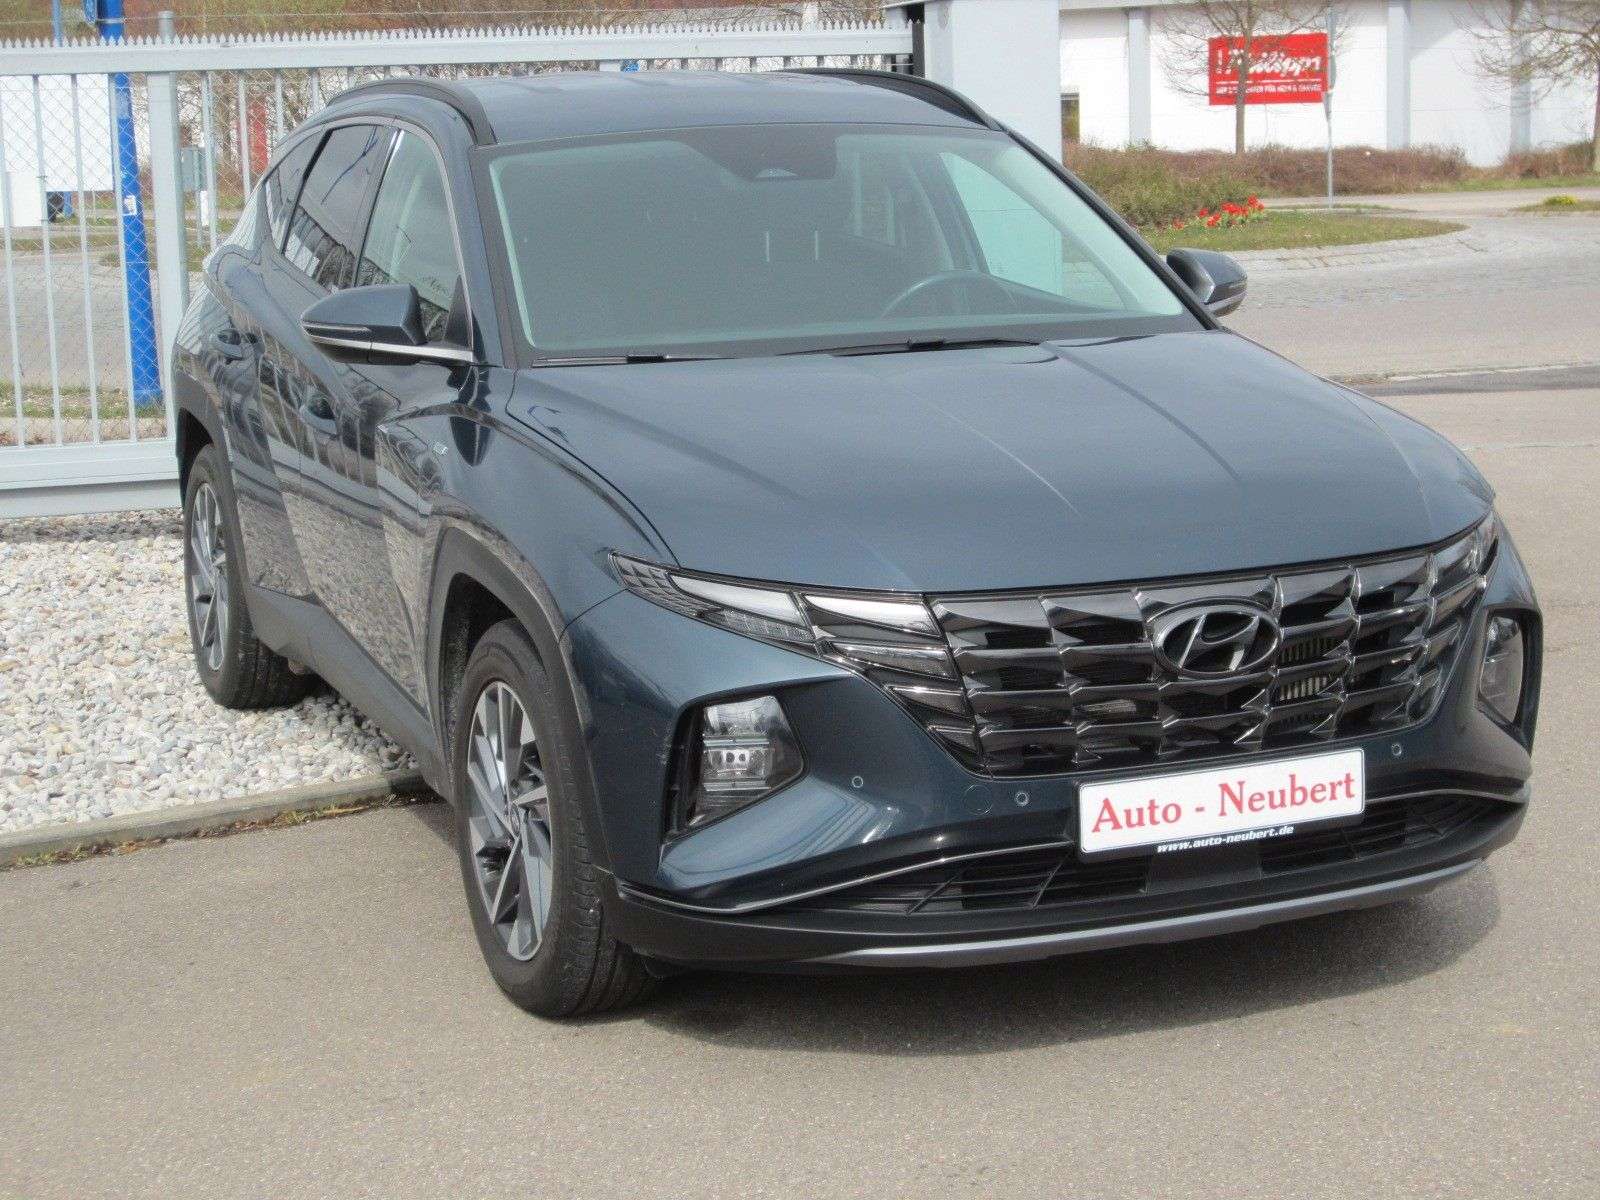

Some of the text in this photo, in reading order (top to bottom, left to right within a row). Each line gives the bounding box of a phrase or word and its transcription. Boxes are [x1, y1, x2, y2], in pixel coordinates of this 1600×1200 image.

[1092, 797, 1182, 833] Auto
[1219, 772, 1356, 817] Neubert
[1156, 825, 1294, 853] www.auto-neubert.de
